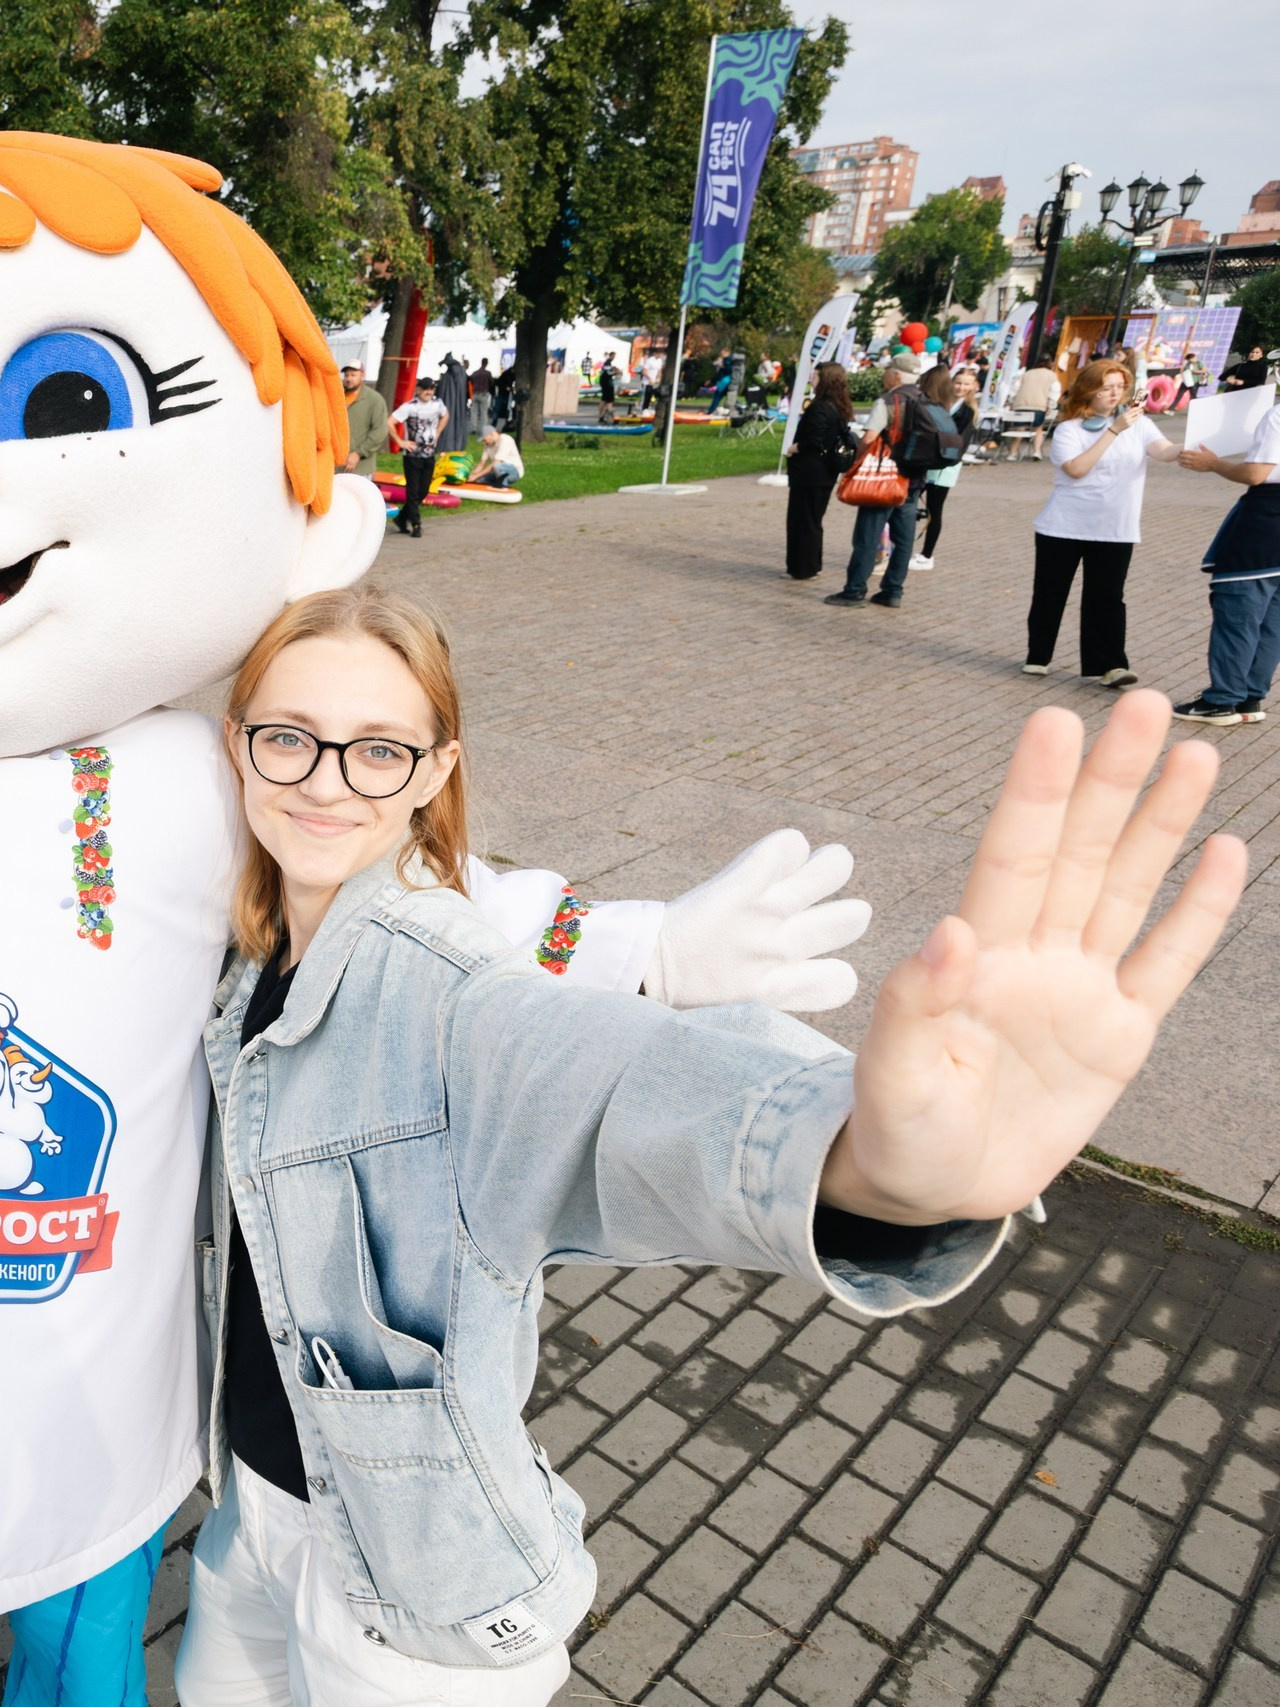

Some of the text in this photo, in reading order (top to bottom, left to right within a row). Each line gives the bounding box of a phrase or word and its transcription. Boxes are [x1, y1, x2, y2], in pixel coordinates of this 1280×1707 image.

[708, 121, 726, 170] САП
[721, 121, 740, 171] ФЕСТ
[709, 174, 738, 226] 74
[486, 1618, 518, 1639] TG
